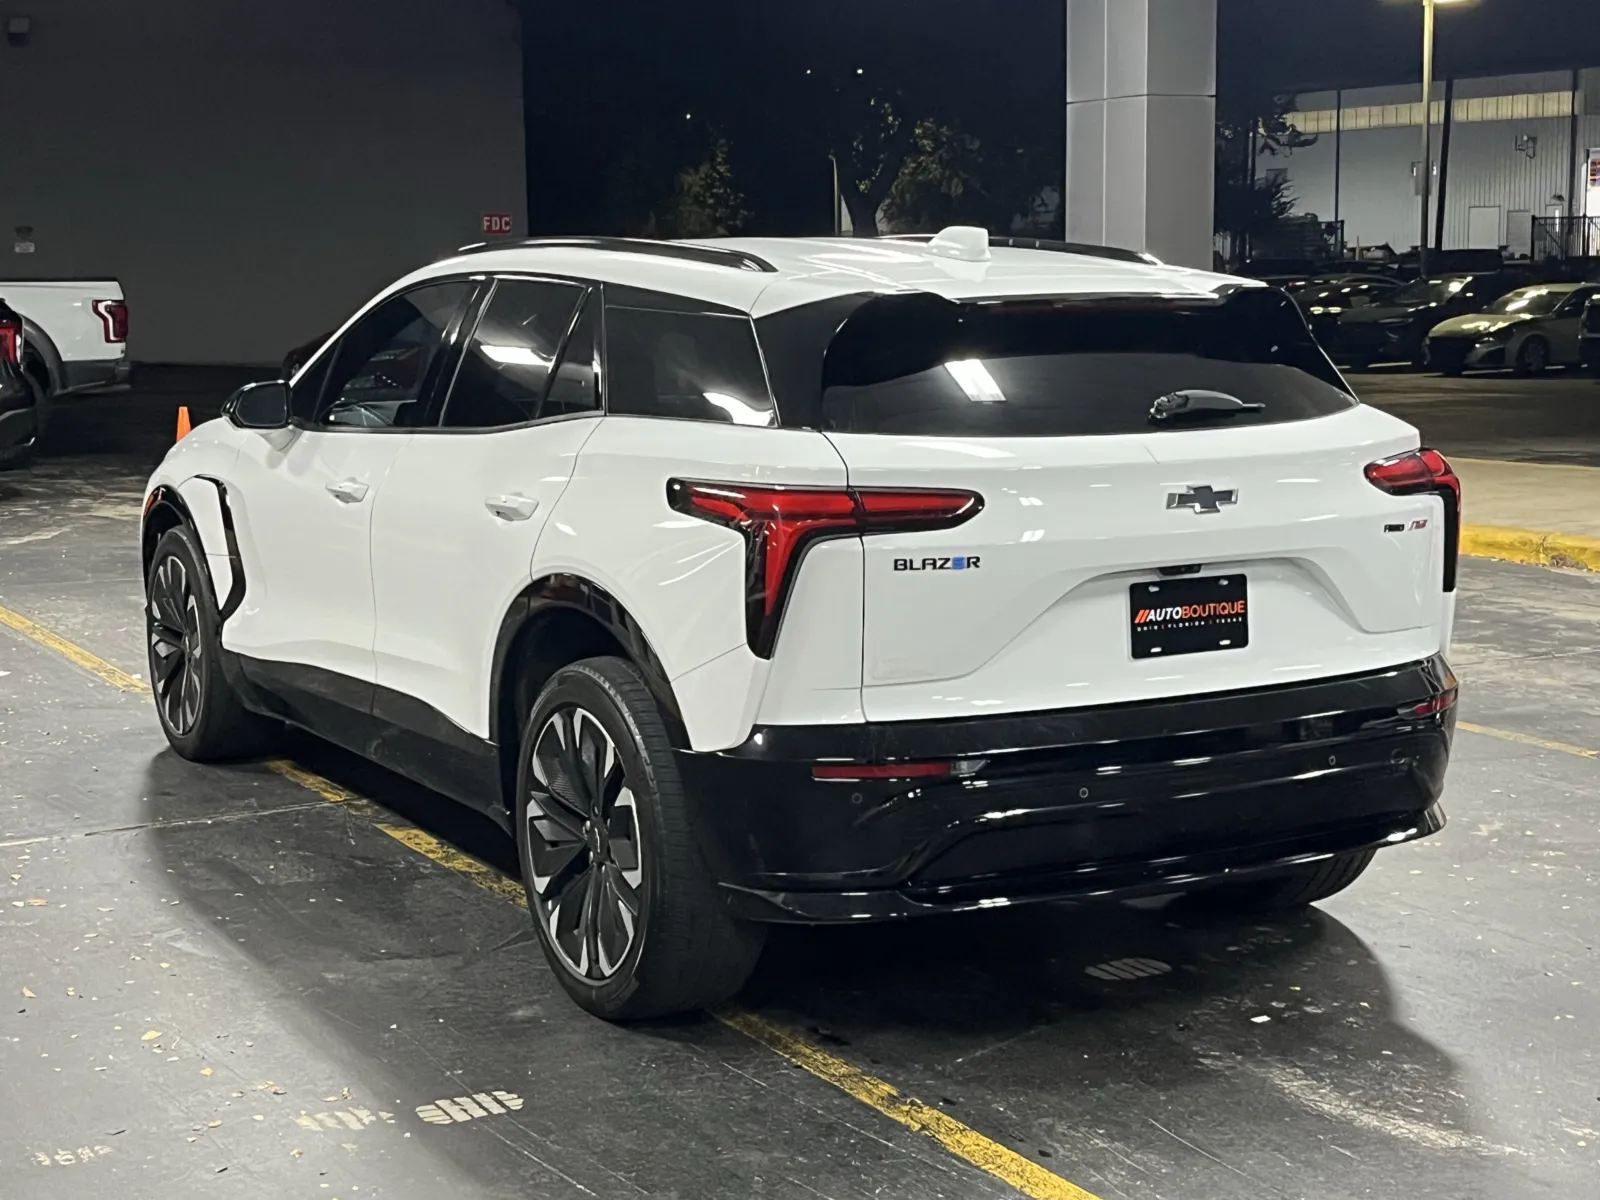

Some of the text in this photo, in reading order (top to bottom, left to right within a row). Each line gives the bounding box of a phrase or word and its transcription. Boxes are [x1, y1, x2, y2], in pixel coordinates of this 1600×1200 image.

[483, 216, 511, 231] FDC
[893, 556, 981, 571] BLAZER
[1146, 601, 1245, 622] AUTOBOUTIQUE
